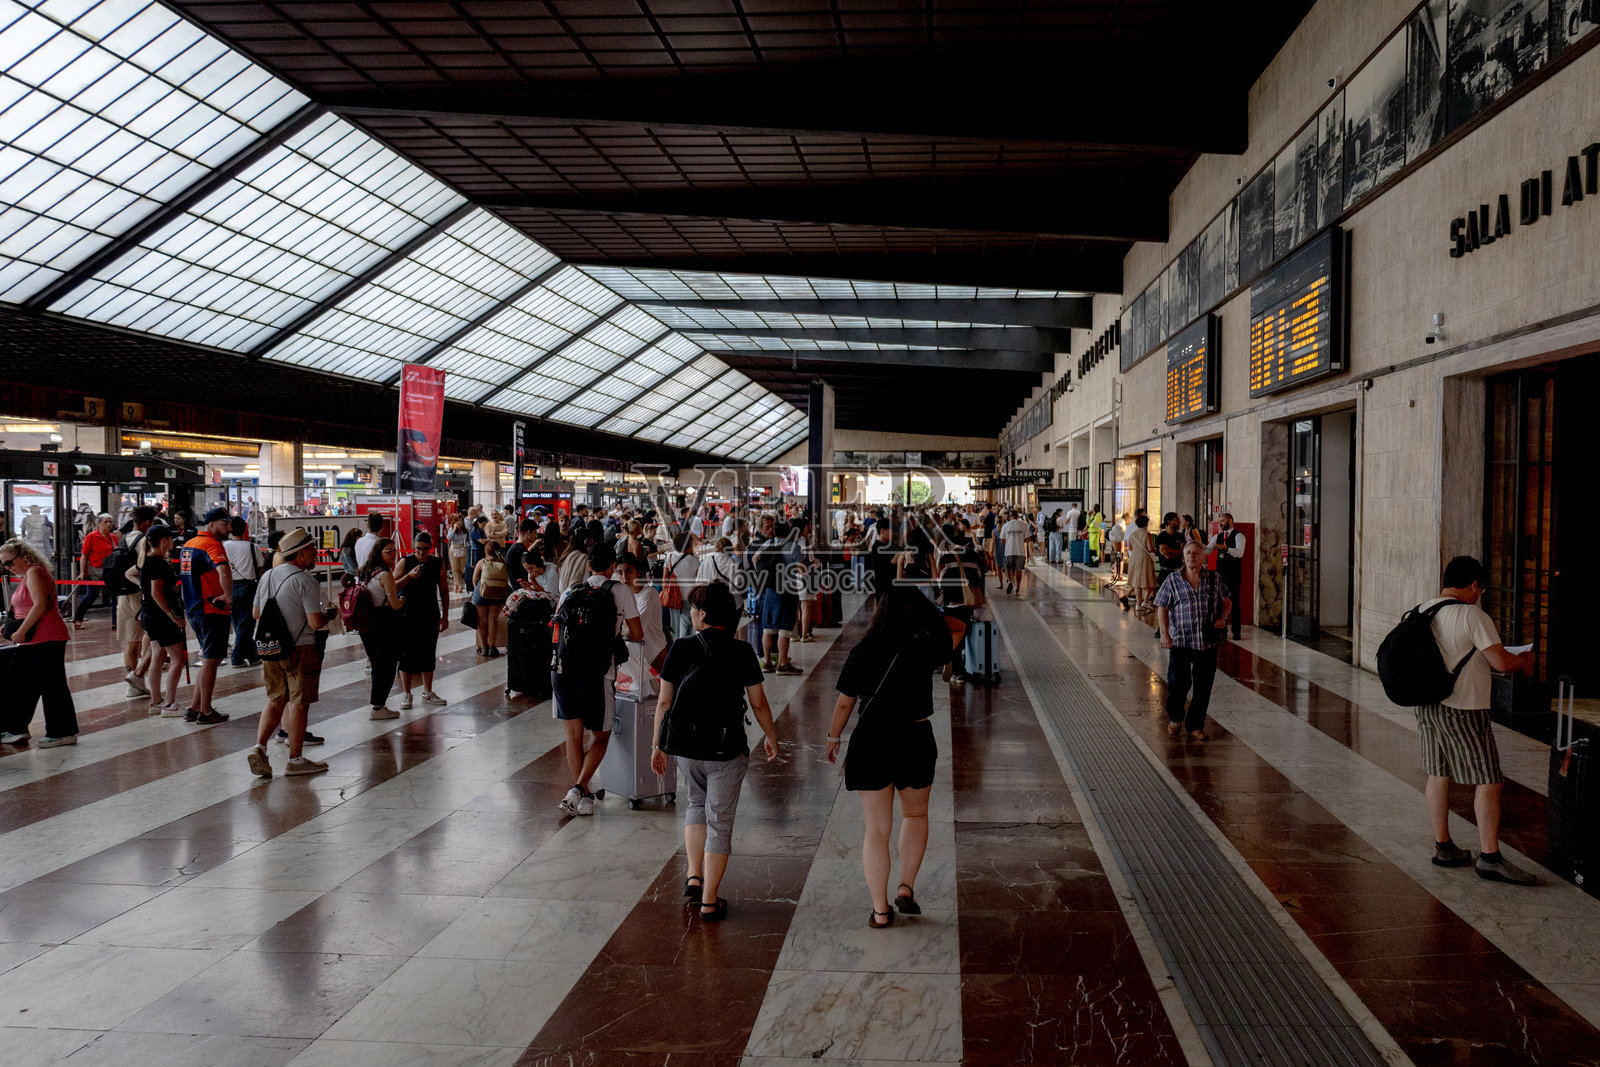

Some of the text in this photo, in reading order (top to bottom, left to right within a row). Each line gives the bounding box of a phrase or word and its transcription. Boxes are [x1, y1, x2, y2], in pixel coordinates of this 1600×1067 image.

[1450, 194, 1511, 258] SALA
[1520, 170, 1552, 225] DI
[89, 401, 97, 417] 8
[127, 405, 134, 421] 9
